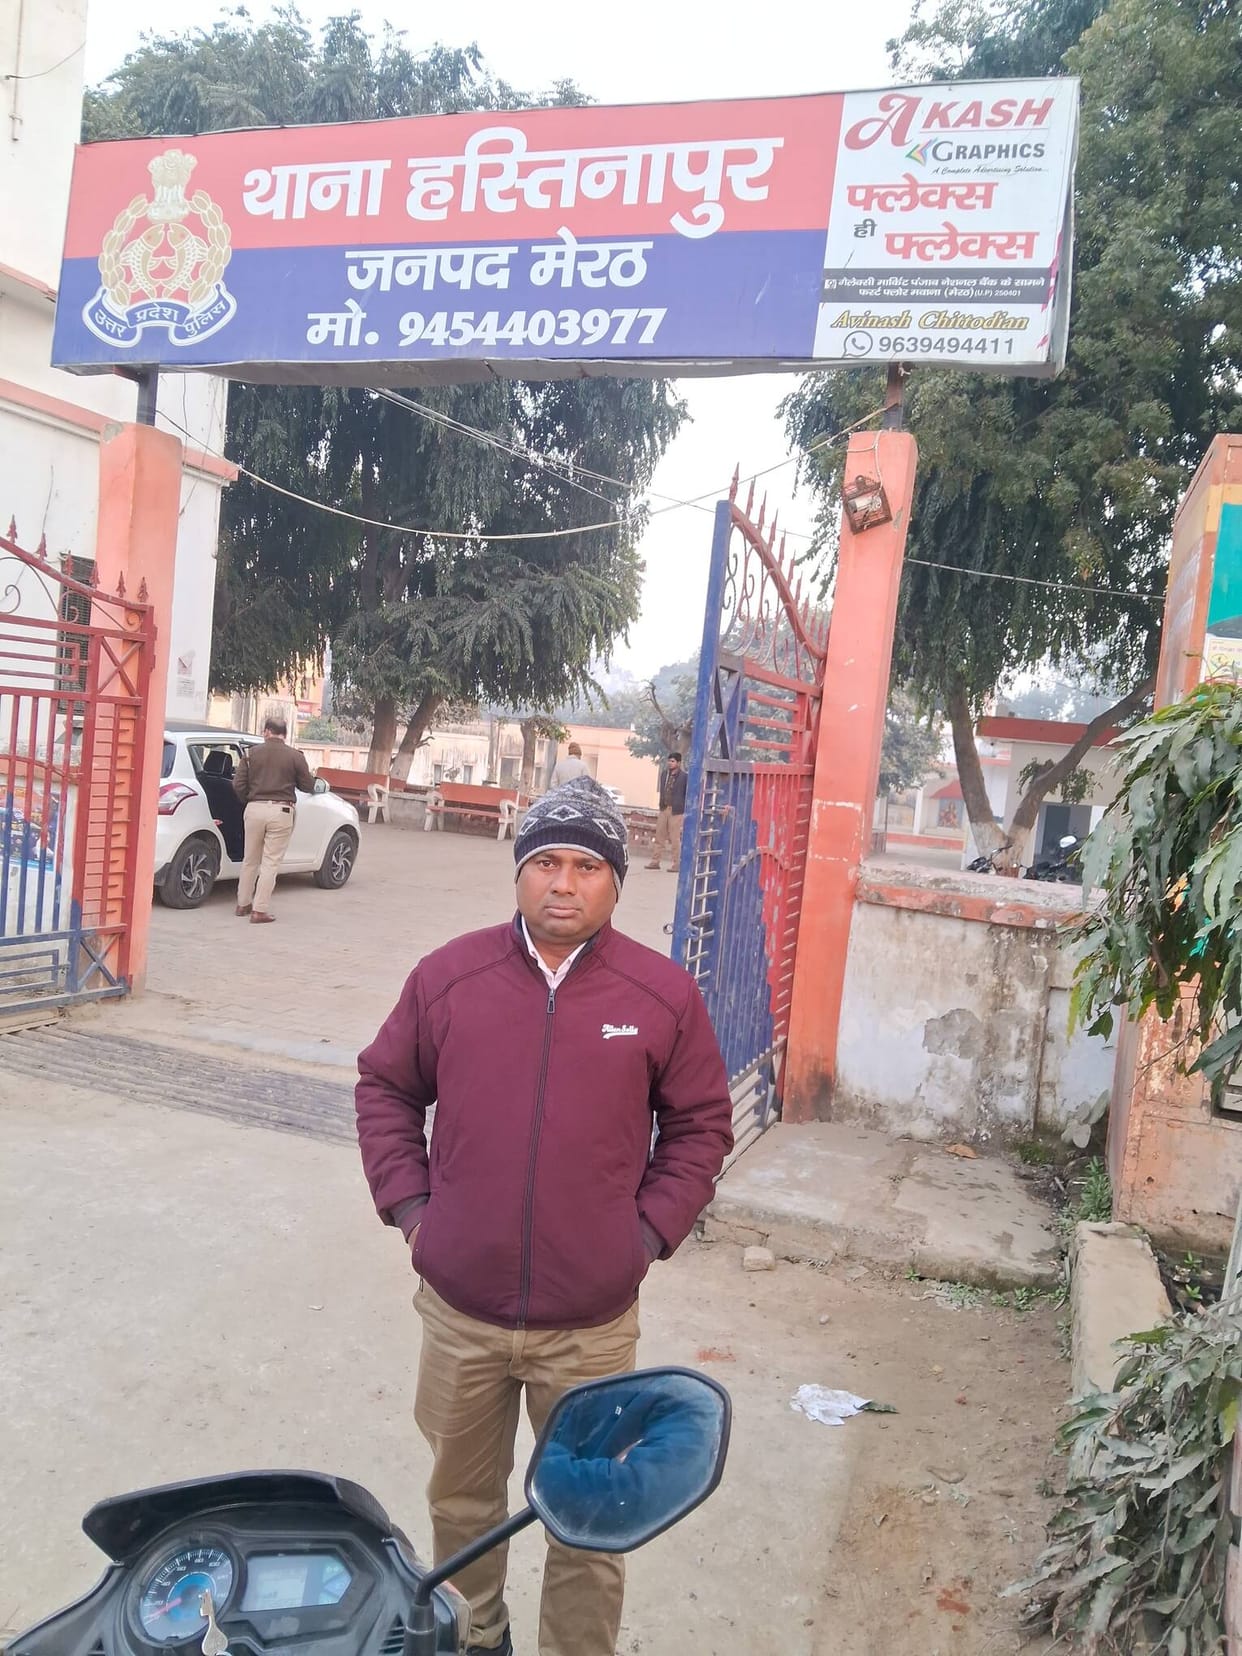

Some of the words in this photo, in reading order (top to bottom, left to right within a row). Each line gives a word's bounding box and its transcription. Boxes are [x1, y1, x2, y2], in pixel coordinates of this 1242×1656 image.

[844, 93, 1054, 150] AKASH
[932, 140, 1045, 162] GRAPHICS
[243, 160, 391, 220] थाना
[406, 126, 784, 238] हस्तिनापुर
[942, 166, 971, 176] Complete
[973, 165, 1011, 175] Advertising
[847, 173, 998, 213] फ्लेक्स
[854, 218, 877, 238] ही
[885, 221, 1040, 262] फ्लेक्स
[345, 247, 518, 291] जनपद
[530, 226, 653, 288] मेरठ
[1000, 276, 1012, 287] के
[95, 309, 127, 337] उत्तर
[135, 303, 179, 322] प्रदेश
[184, 301, 226, 338] पुलिस
[307, 298, 379, 346] मो.
[398, 308, 667, 347] 9454403977
[830, 310, 912, 329] Avinash
[918, 310, 1029, 330] Chittodian
[879, 336, 1014, 355] 9639494411
